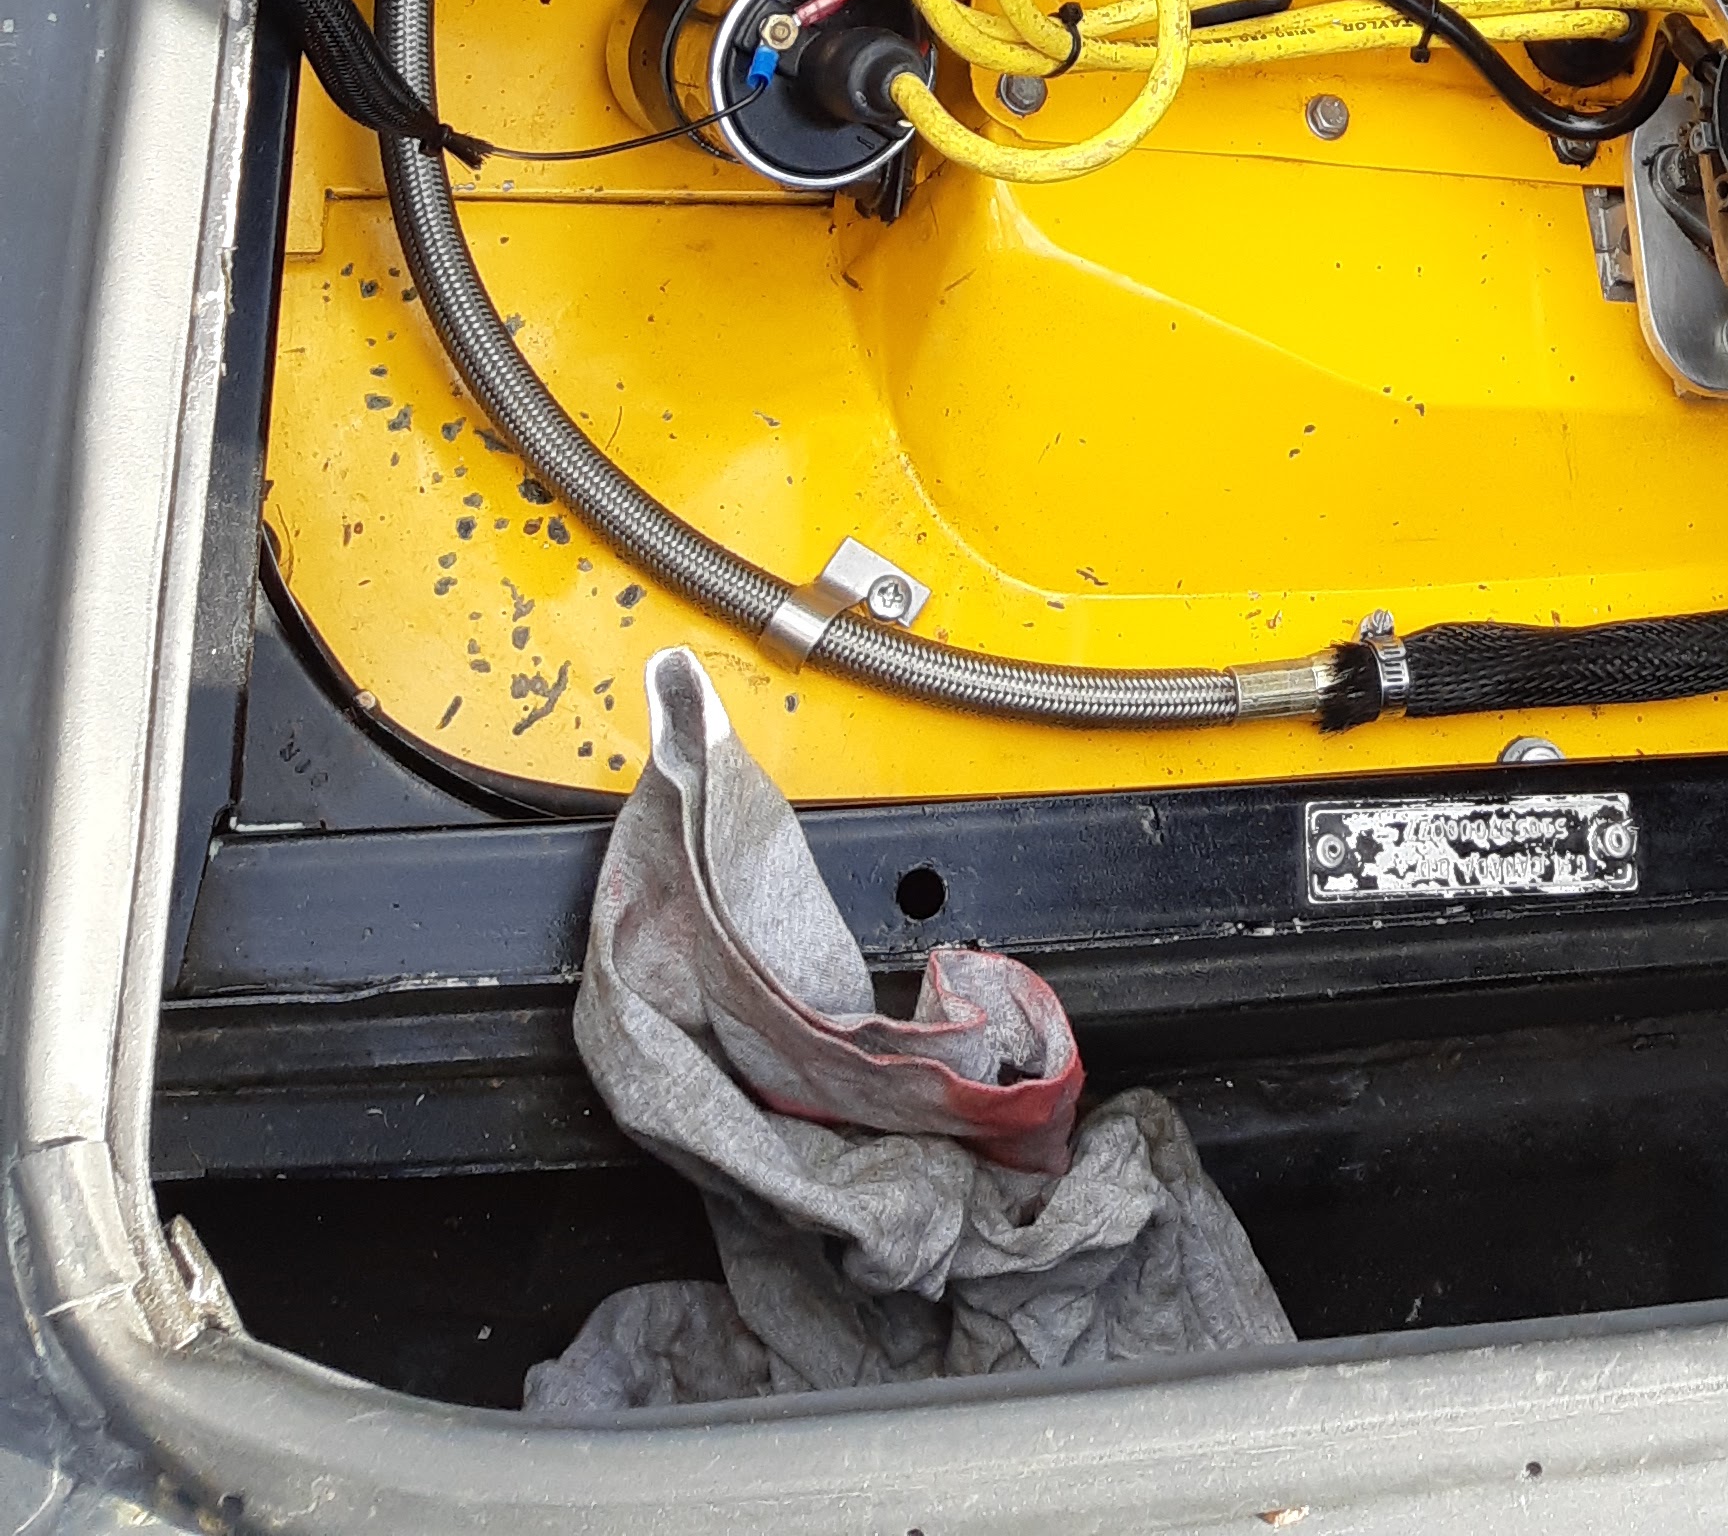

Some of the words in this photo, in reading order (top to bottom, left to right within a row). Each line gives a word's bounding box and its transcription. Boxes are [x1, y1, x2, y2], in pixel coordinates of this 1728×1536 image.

[1342, 18, 1414, 32] TAYLOR
[1241, 33, 1268, 43] PRO
[1275, 27, 1316, 39] SPIRO
